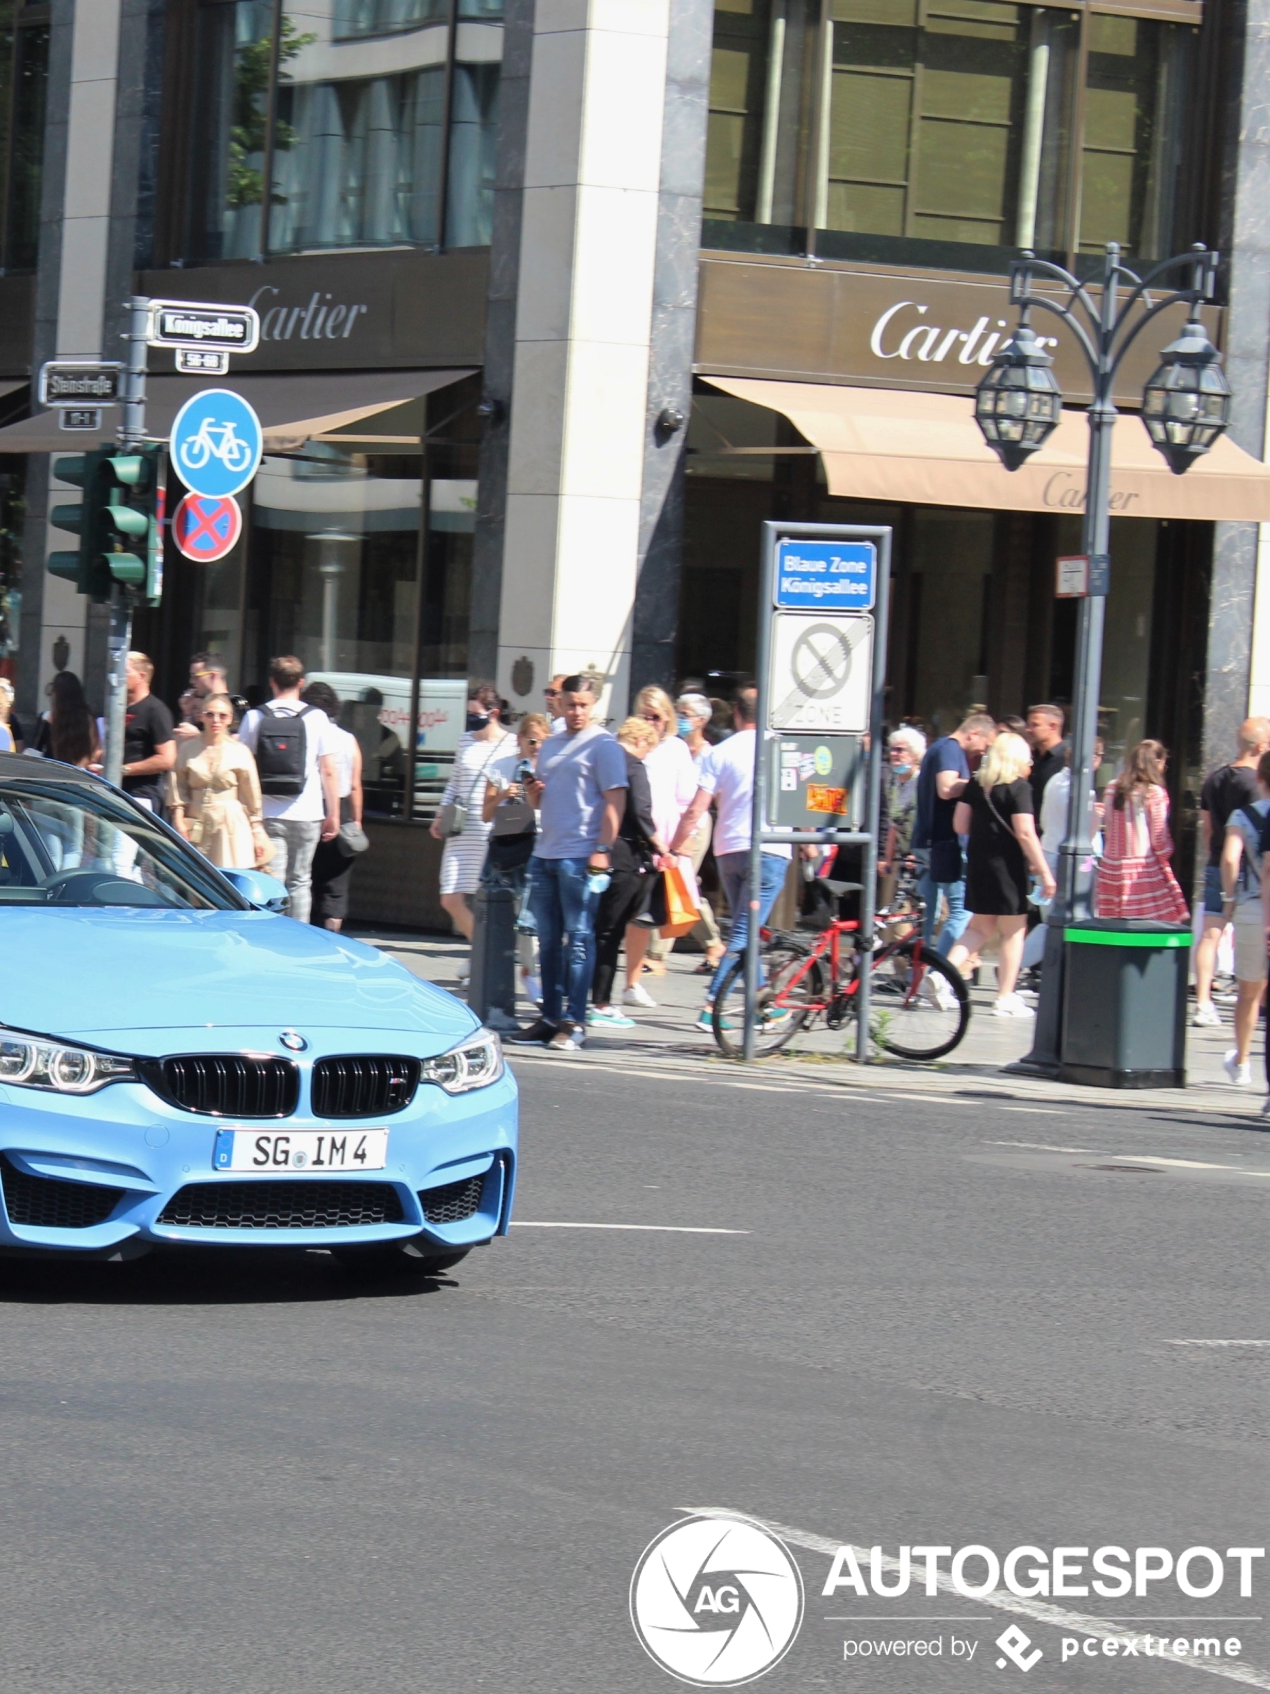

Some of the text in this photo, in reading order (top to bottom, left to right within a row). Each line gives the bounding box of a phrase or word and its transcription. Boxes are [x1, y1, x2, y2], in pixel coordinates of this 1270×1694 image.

[164, 314, 244, 339] Königsallee
[50, 375, 113, 396] Steinstraße
[783, 555, 868, 574] Blaue Zone
[780, 577, 869, 598] Königsallee
[793, 704, 842, 724] ZONE
[219, 1153, 228, 1163] D
[252, 1135, 290, 1166] SG
